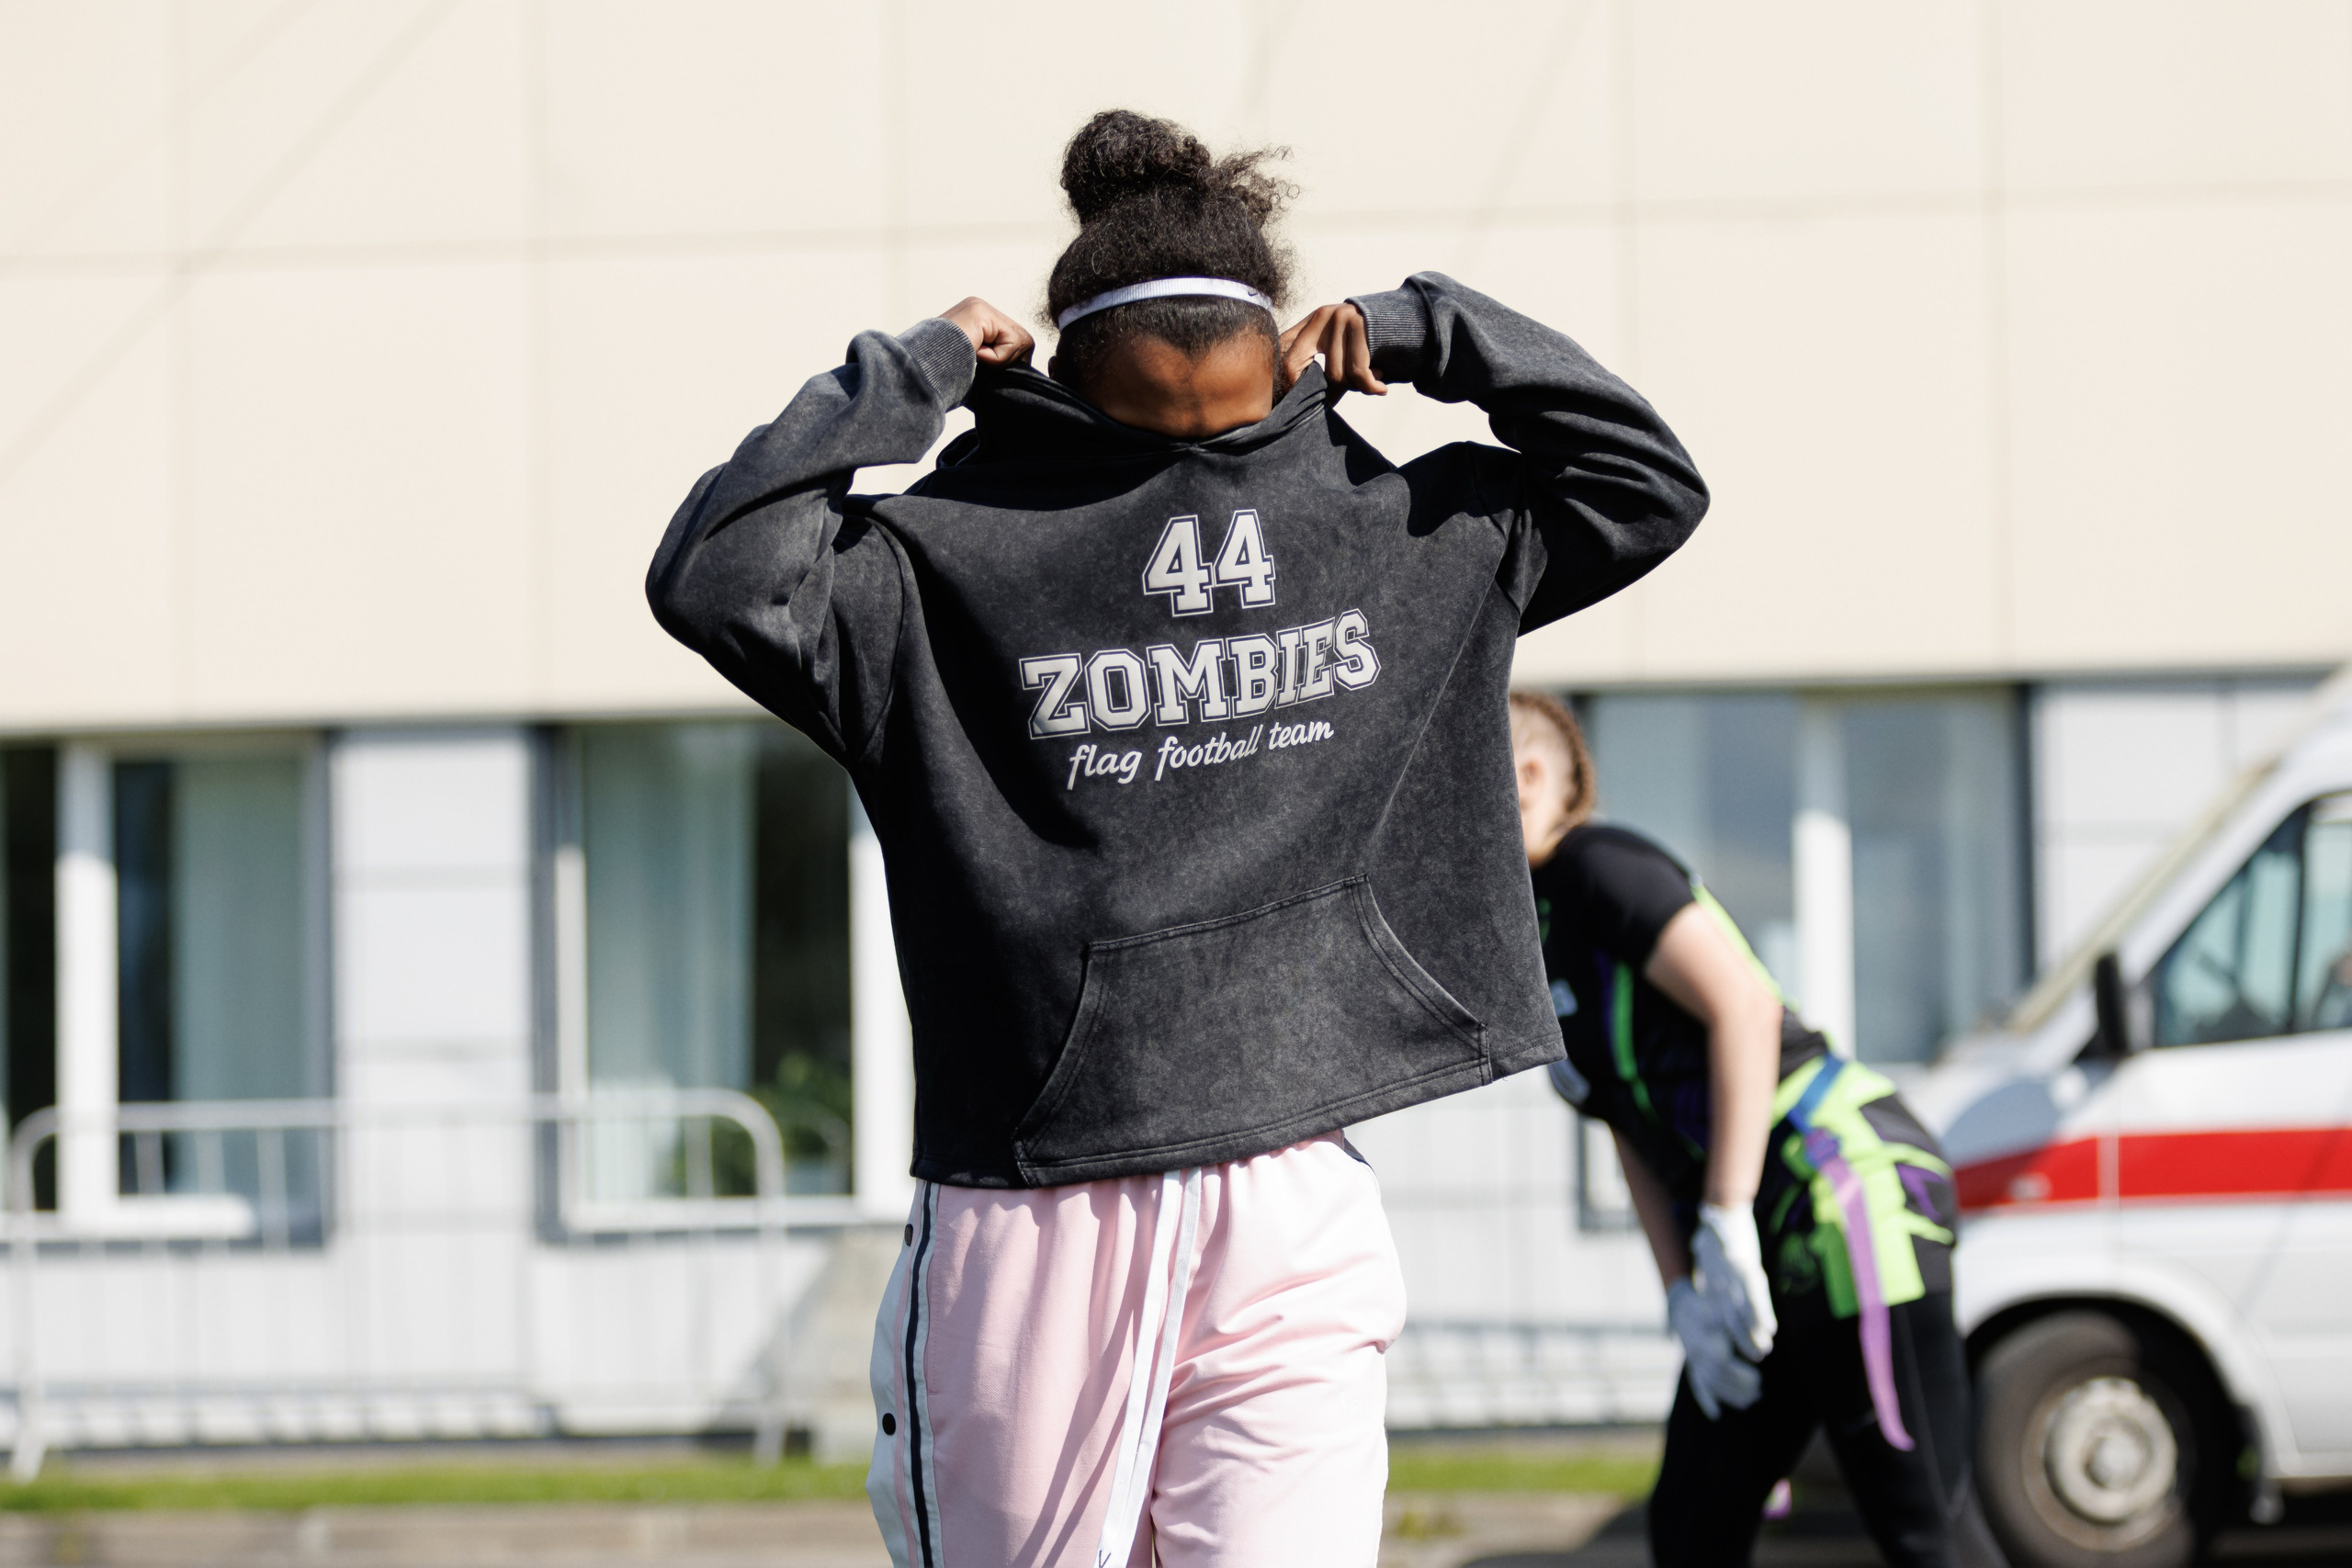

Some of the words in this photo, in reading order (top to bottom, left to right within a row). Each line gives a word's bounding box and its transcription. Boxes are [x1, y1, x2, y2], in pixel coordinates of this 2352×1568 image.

[1142, 509, 1276, 616] 44
[1019, 608, 1381, 739] ZOMBIES
[1067, 744, 1142, 790] flag
[1155, 724, 1263, 781] football
[1269, 721, 1334, 750] team
